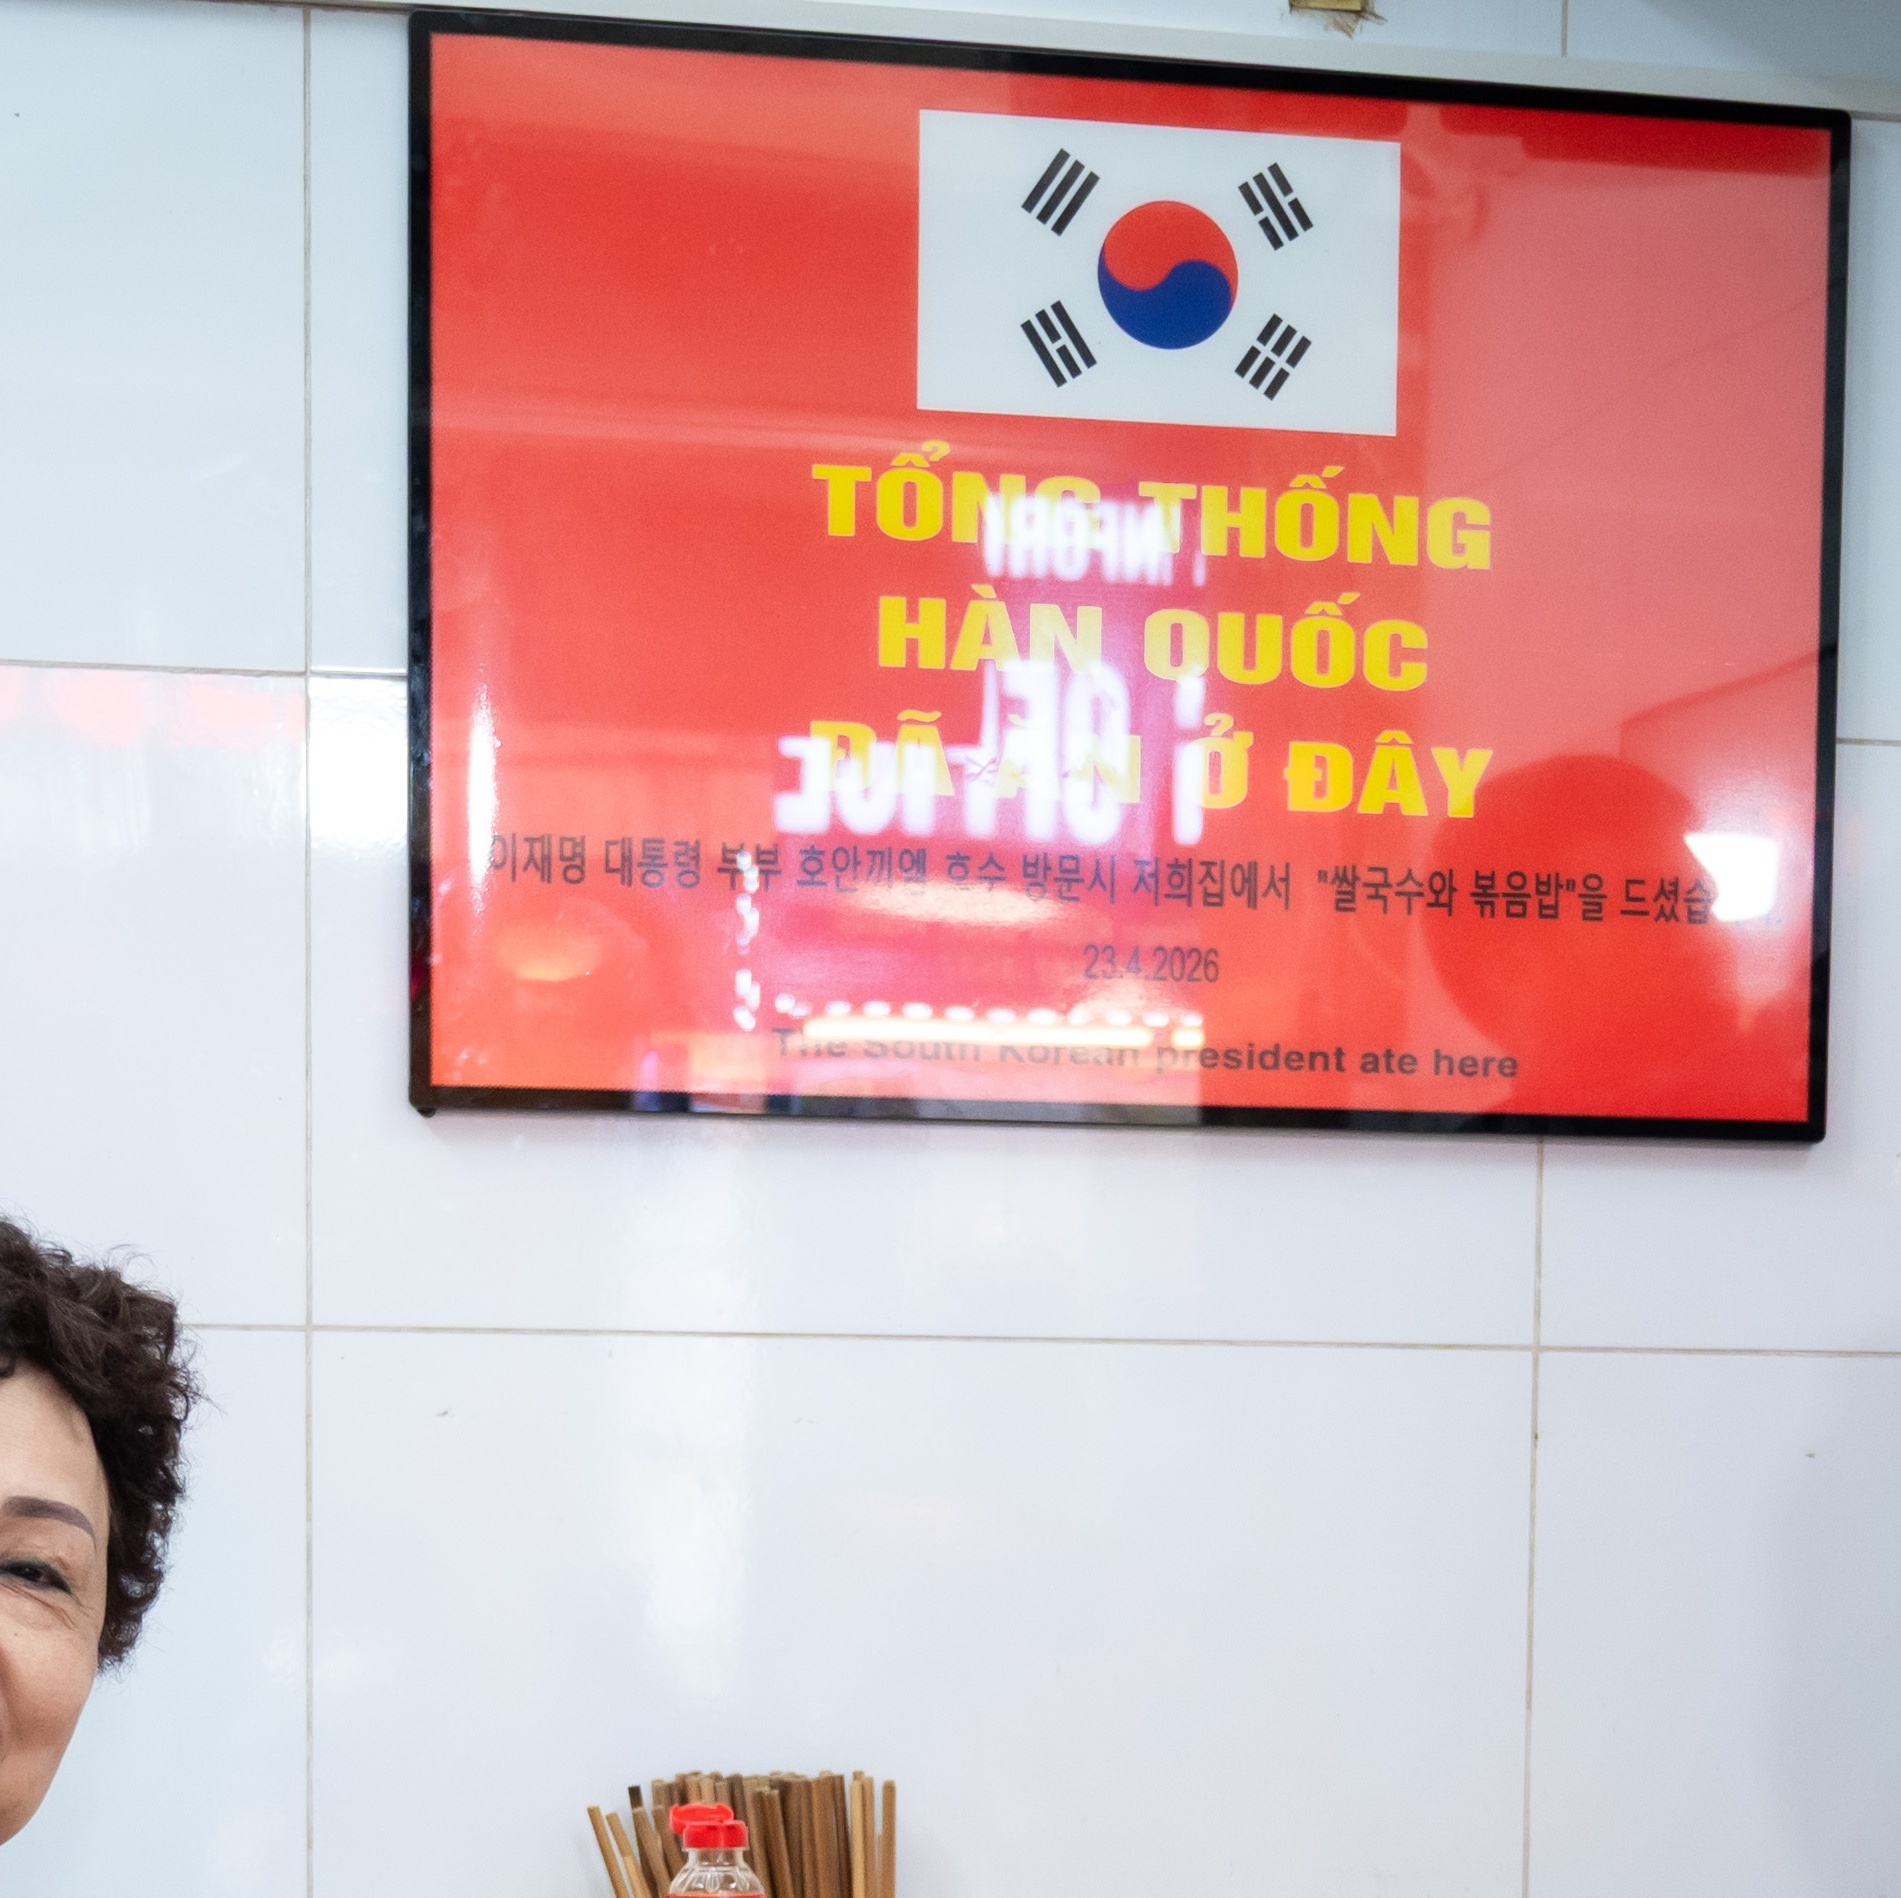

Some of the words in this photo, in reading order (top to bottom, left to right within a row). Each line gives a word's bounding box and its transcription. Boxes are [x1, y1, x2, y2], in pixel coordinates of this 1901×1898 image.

[1139, 466, 1491, 569] THỐNG
[878, 583, 1103, 675] HÀN
[1144, 592, 1429, 692] QUỐC
[1182, 713, 1254, 809] Ở
[1284, 729, 1494, 818] ĐÂY
[490, 832, 587, 885] 이재명
[603, 836, 702, 890] 대통령
[716, 841, 783, 891] 부부
[945, 850, 1007, 892] 호수
[1022, 852, 1117, 904] 방문시
[1132, 856, 1292, 911] 저희집에서
[1083, 943, 1220, 983] 23.4.2026
[1156, 1043, 1346, 1075] president
[1359, 1047, 1419, 1076] ate
[1432, 1048, 1519, 1079] here
